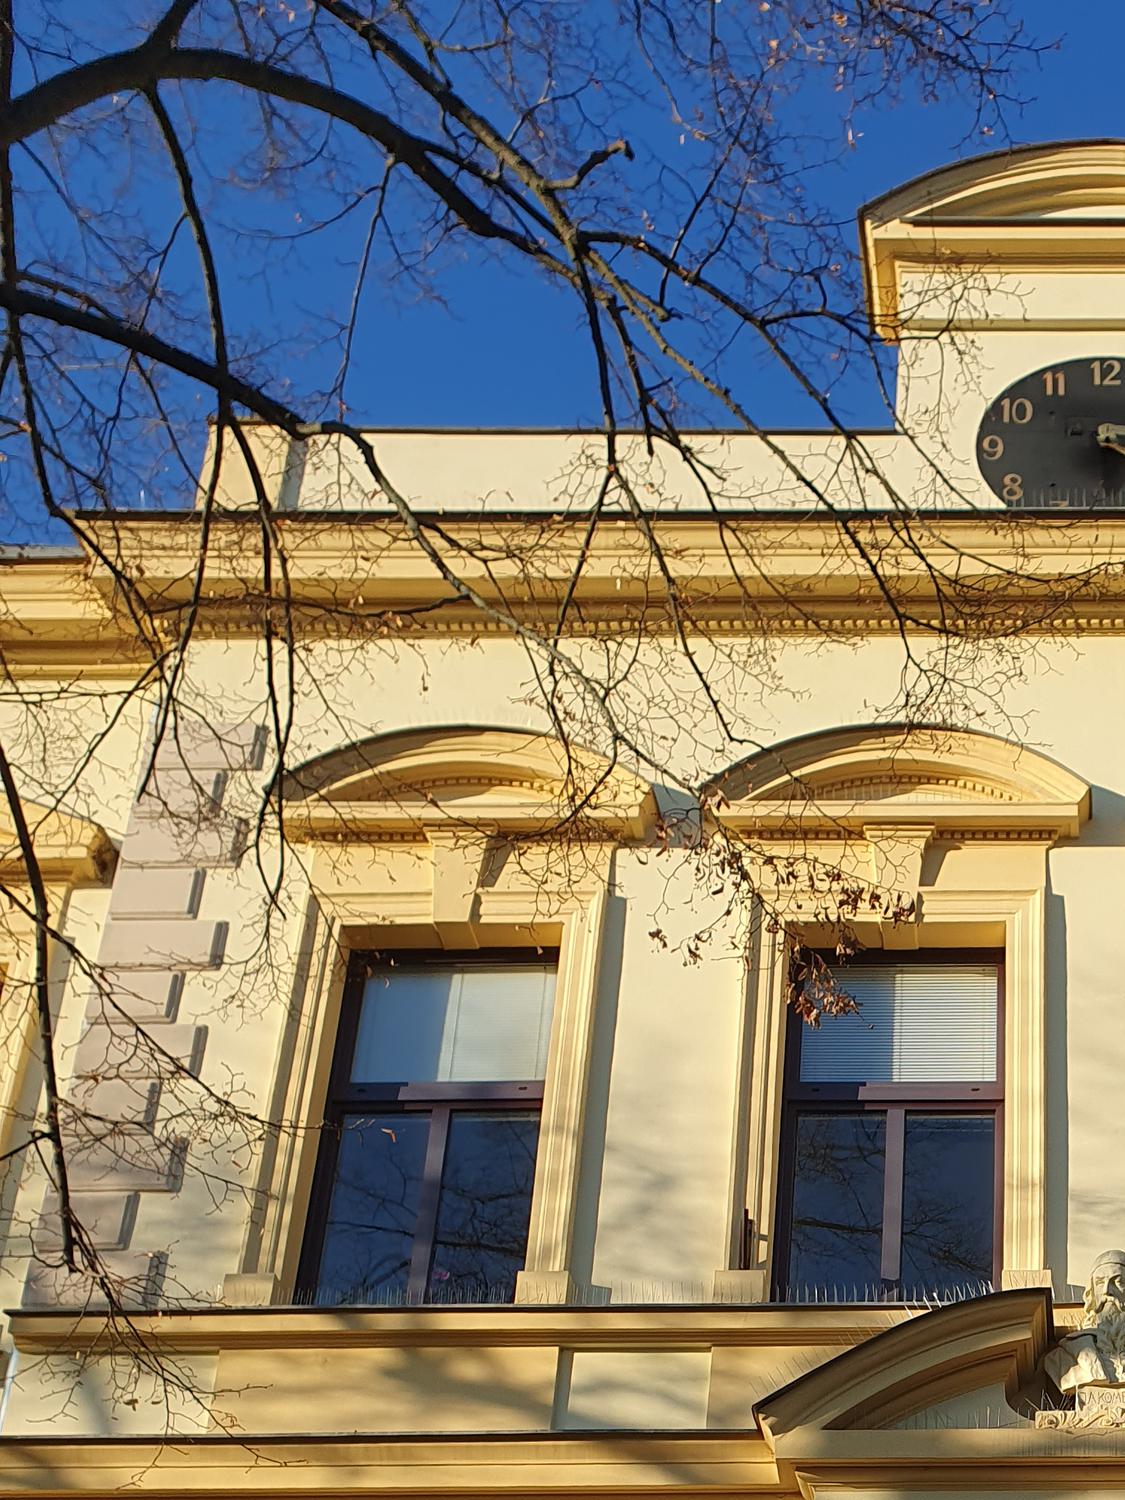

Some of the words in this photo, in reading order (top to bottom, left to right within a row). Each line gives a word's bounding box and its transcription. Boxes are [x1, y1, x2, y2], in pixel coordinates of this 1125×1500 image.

[1043, 370, 1066, 396] 11
[1090, 359, 1122, 386] 12
[1001, 398, 1034, 424] 10
[982, 435, 1005, 461] 9
[1002, 473, 1024, 501] 8
